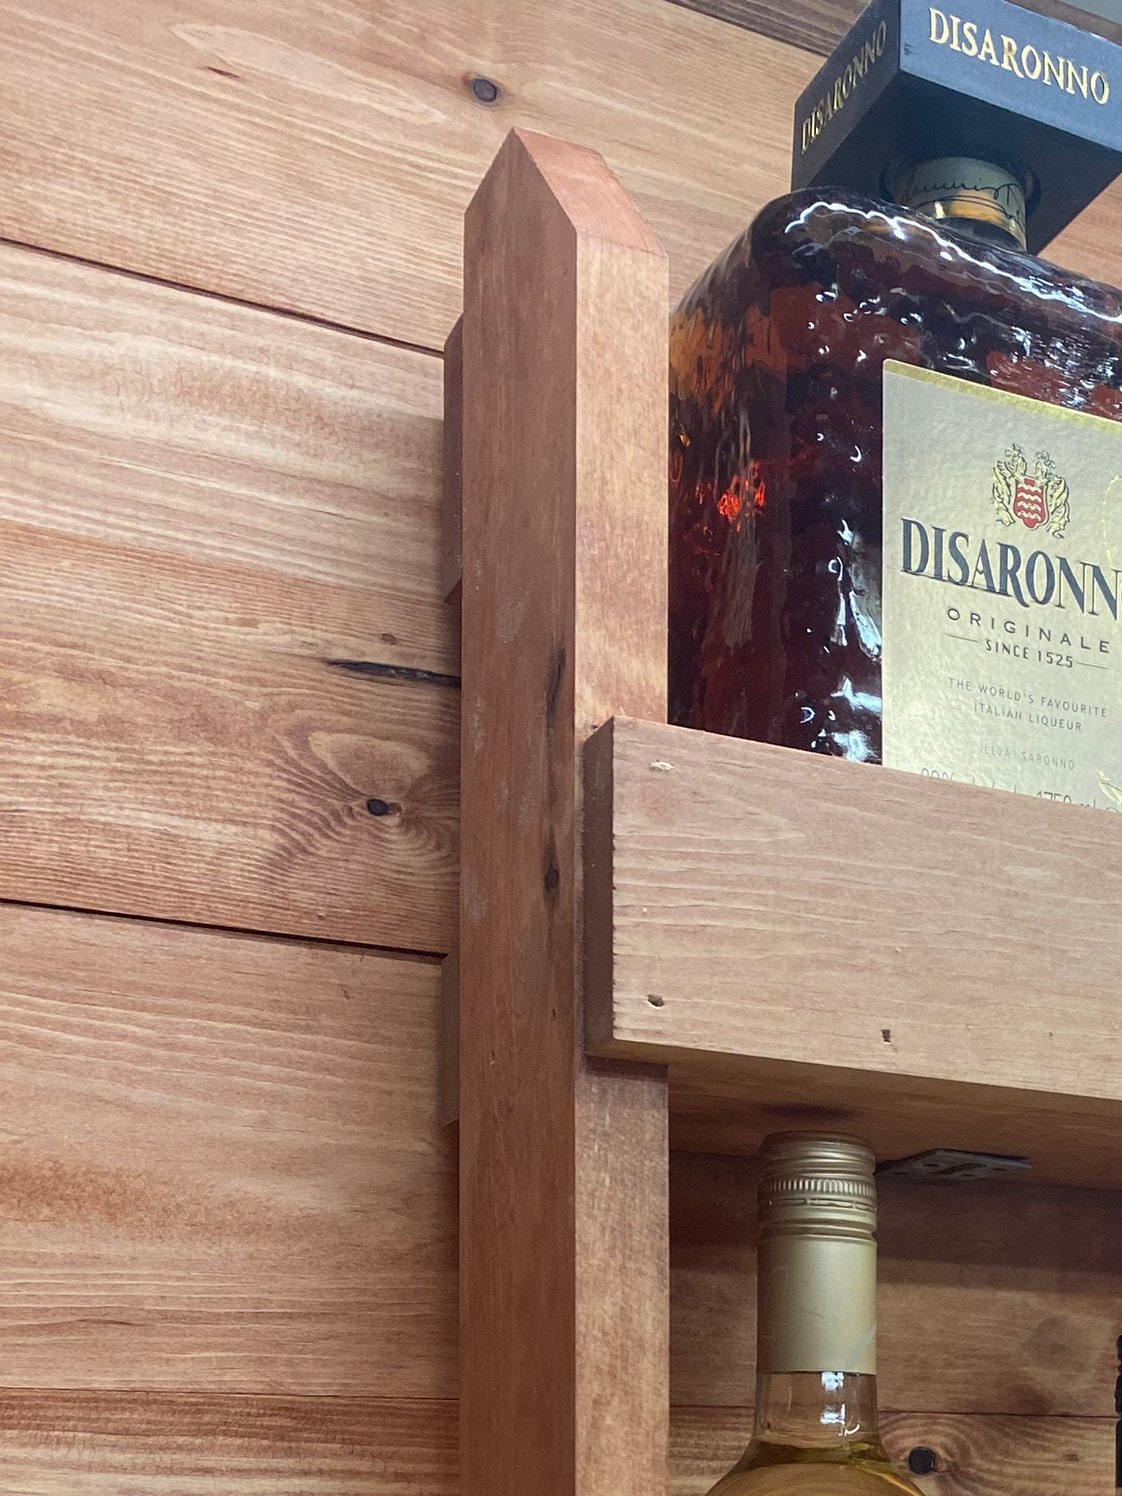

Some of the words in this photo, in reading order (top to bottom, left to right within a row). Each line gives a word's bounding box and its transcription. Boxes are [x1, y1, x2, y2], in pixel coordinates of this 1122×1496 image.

[929, 6, 1110, 106] DISARONNO
[801, 20, 888, 155] DISARONNO
[946, 608, 1110, 654] ORIGINALE
[985, 638, 1030, 660] SINCE
[1037, 650, 1074, 668] 1525
[949, 677, 973, 692] THE
[978, 683, 1035, 705] WORLD'S
[1040, 696, 1108, 719] FAVOURITE
[973, 702, 1023, 720] ITALIAN
[1028, 712, 1083, 732] LIQUEUR
[1021, 751, 1076, 771] SARONNO
